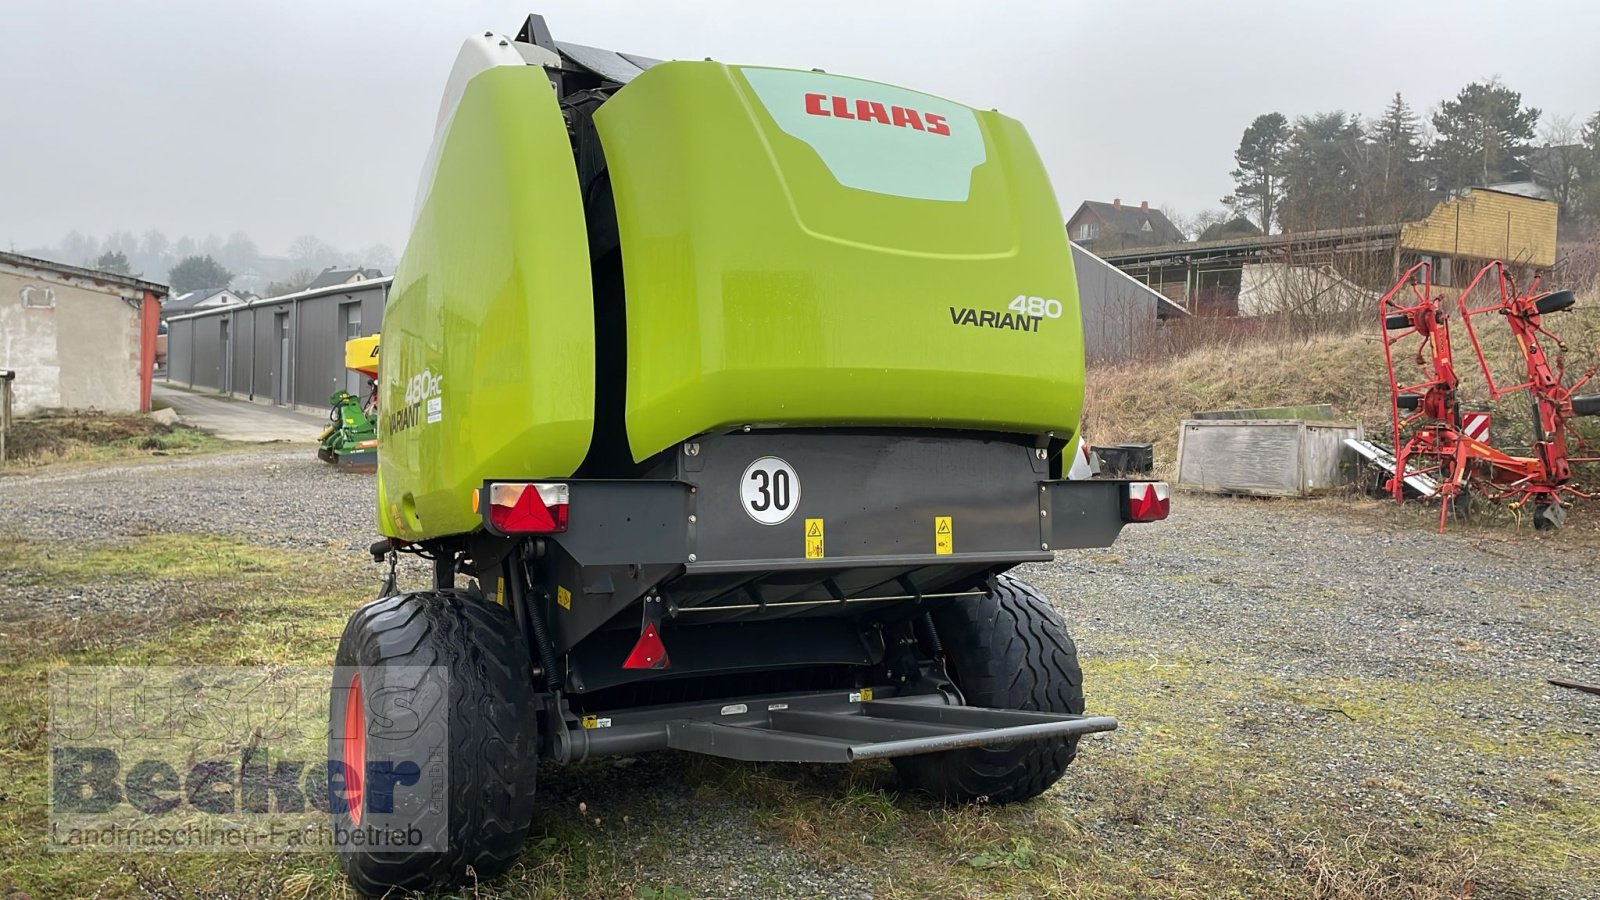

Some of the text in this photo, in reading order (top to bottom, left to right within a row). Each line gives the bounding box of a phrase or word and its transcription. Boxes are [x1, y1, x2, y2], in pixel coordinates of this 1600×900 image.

[804, 93, 951, 137] CLAAS
[949, 306, 1043, 333] VARIANT
[1008, 294, 1063, 319] 480
[388, 402, 421, 436] VARIANT
[750, 469, 790, 512] 30
